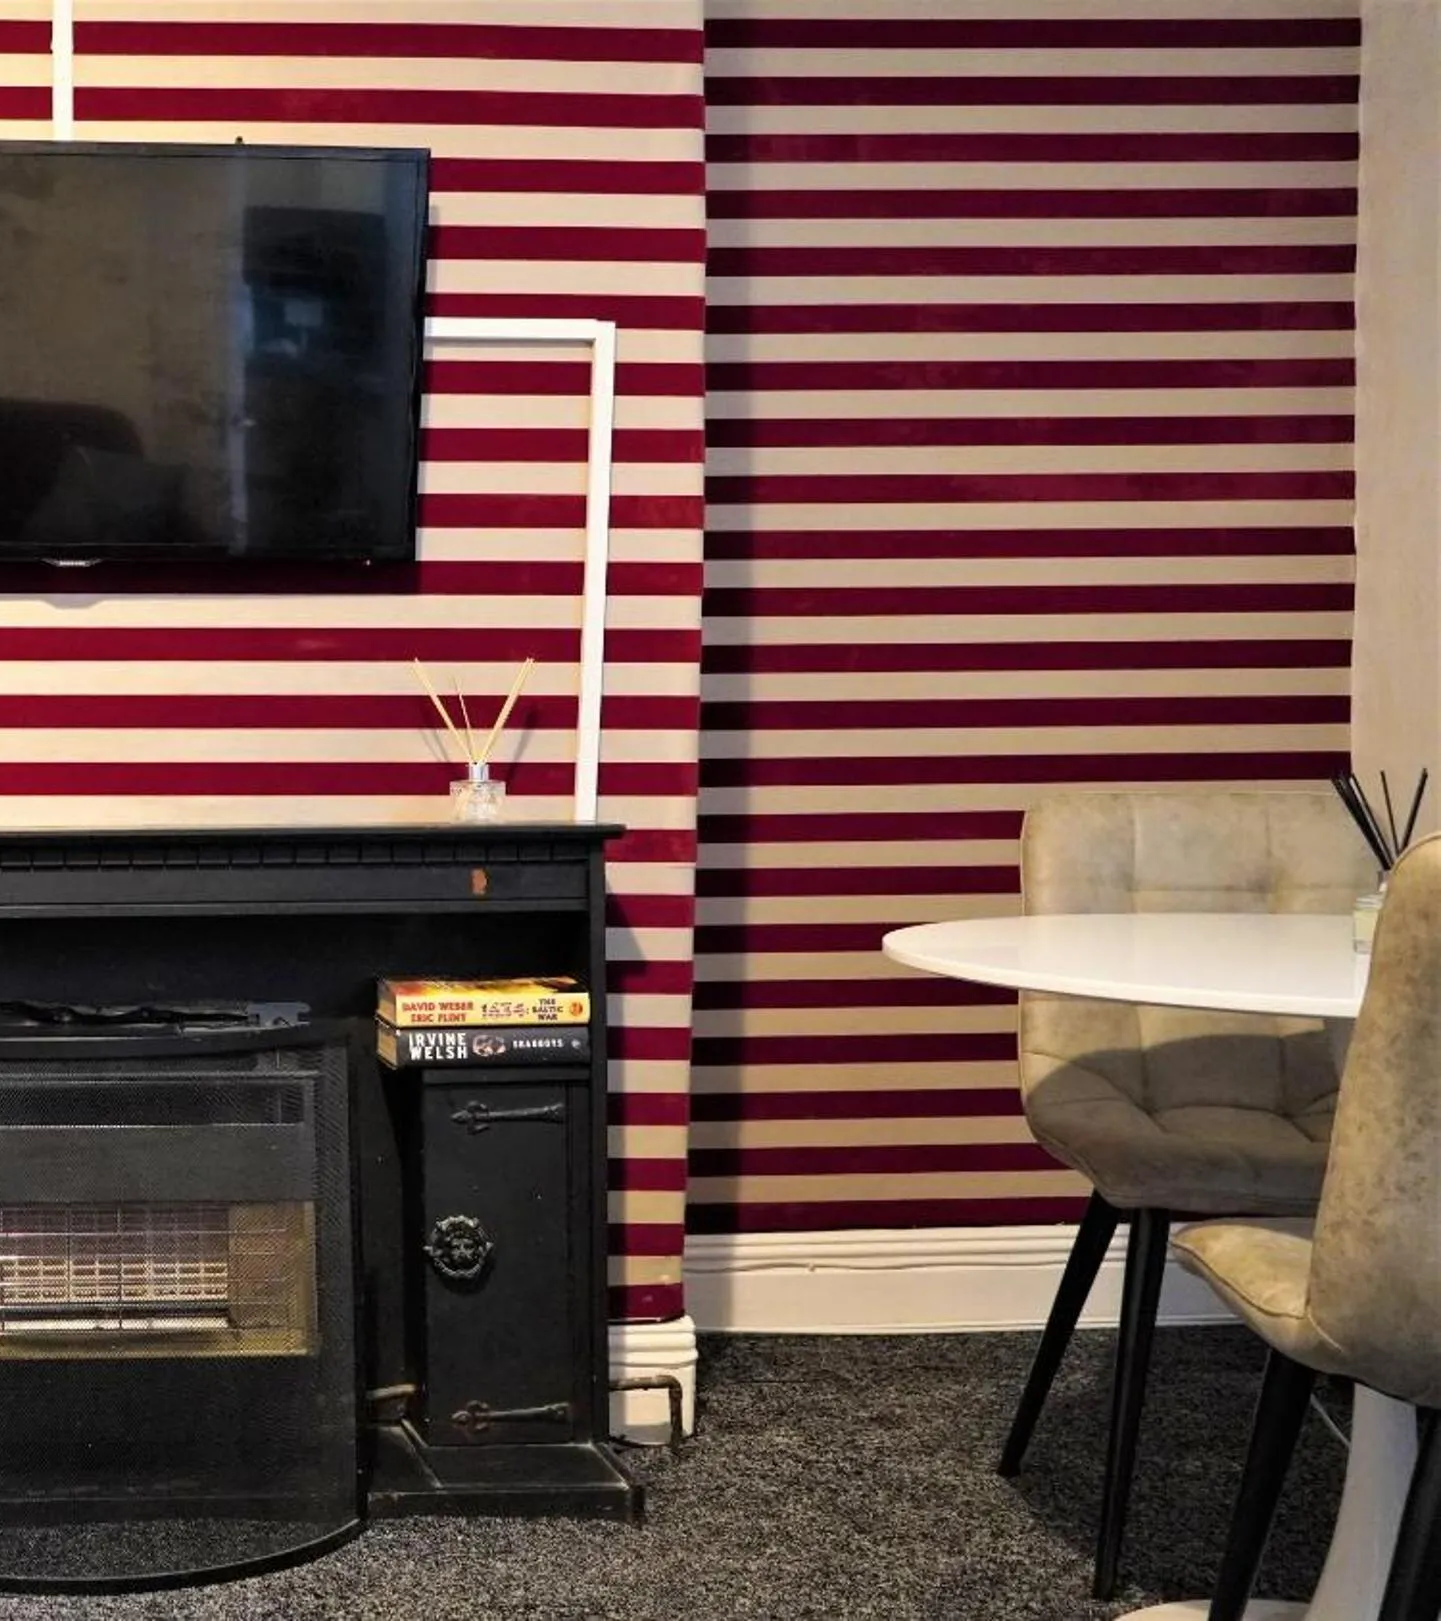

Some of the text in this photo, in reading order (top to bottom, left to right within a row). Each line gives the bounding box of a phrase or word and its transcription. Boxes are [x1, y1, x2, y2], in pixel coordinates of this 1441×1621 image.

[402, 1001, 474, 1012] DAVID WEBER
[410, 1013, 467, 1023] ERIC FLINT
[409, 1032, 467, 1046] IRVINE
[410, 1046, 469, 1060] WELSH
